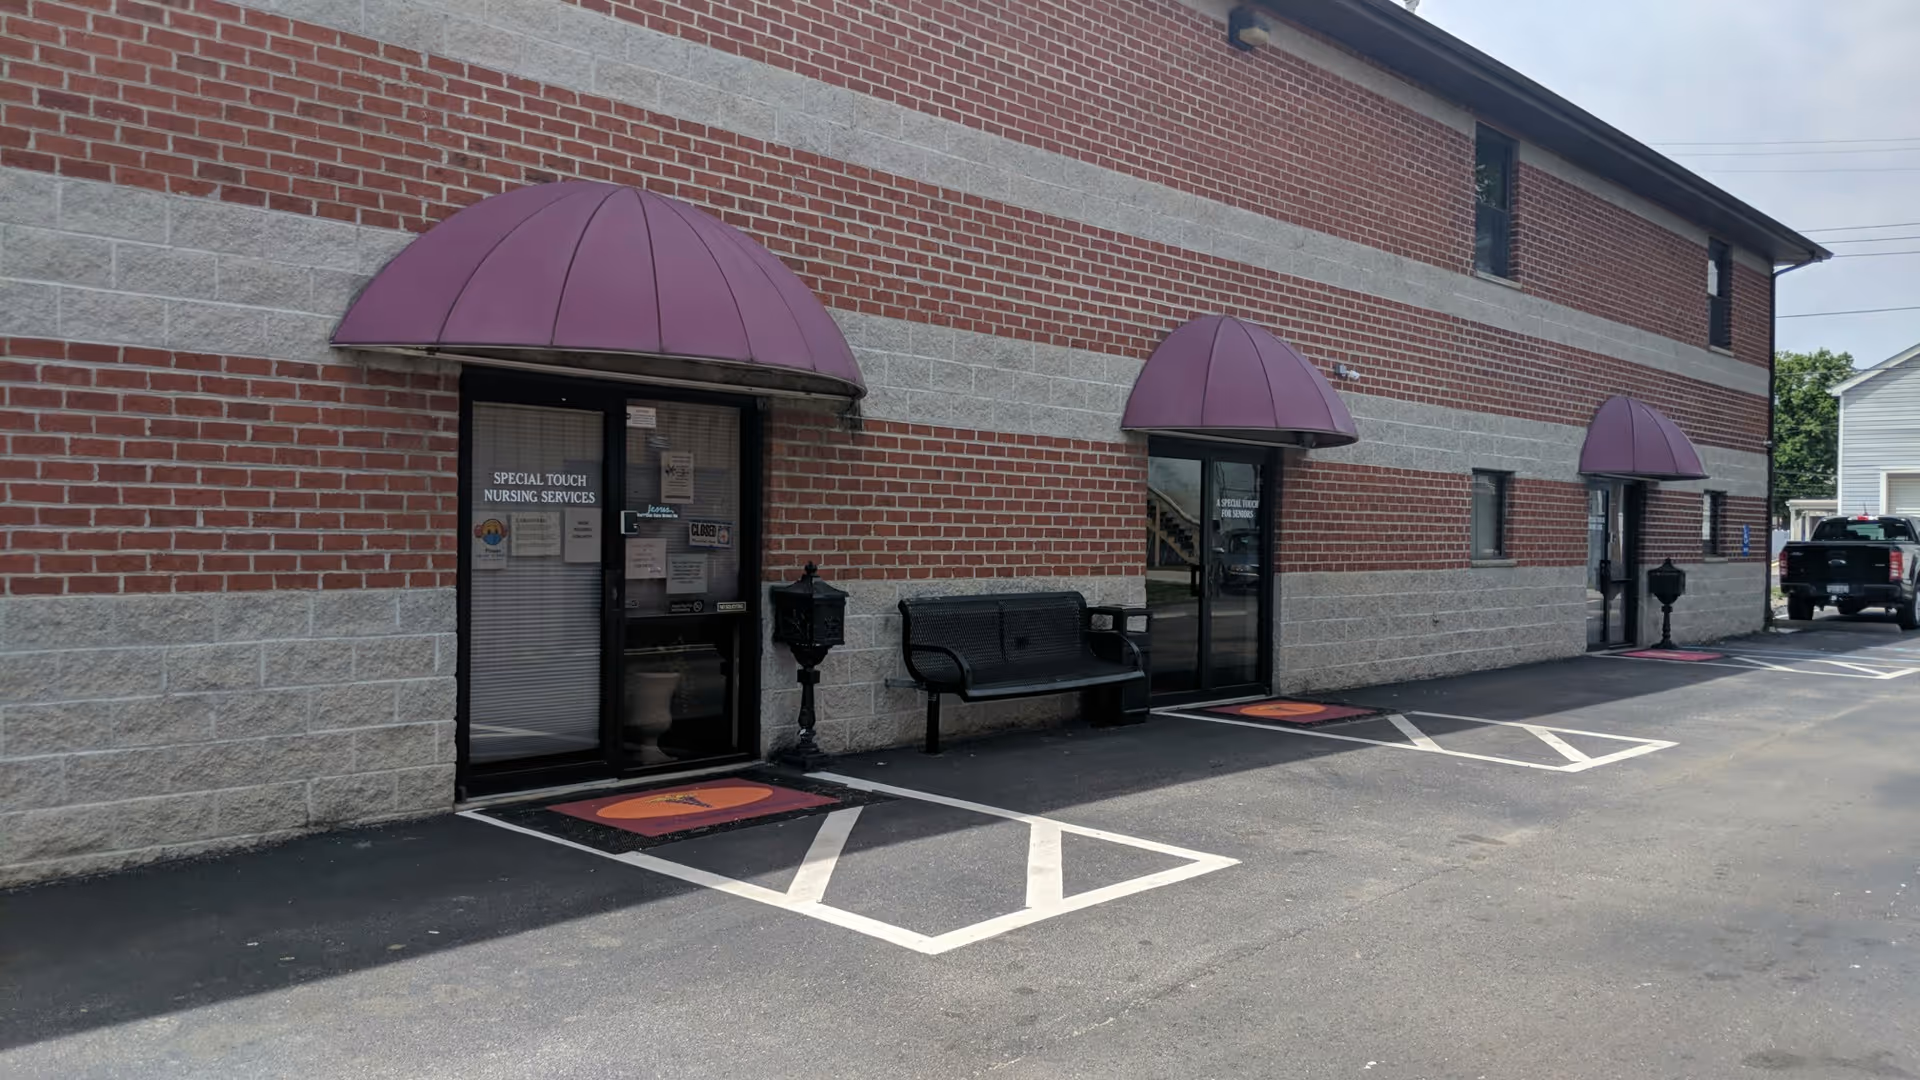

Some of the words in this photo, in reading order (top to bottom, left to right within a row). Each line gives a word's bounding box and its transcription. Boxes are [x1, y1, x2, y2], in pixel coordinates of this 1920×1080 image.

[493, 472, 544, 485] SPECIAL
[546, 473, 587, 487] TOUCH
[484, 489, 538, 503] NURSING
[541, 491, 596, 504] SERVICES
[1221, 498, 1242, 508] SPECIAL
[1221, 509, 1232, 518] FOR
[1233, 509, 1254, 519] SENIORS
[691, 523, 717, 537] CLOSED
